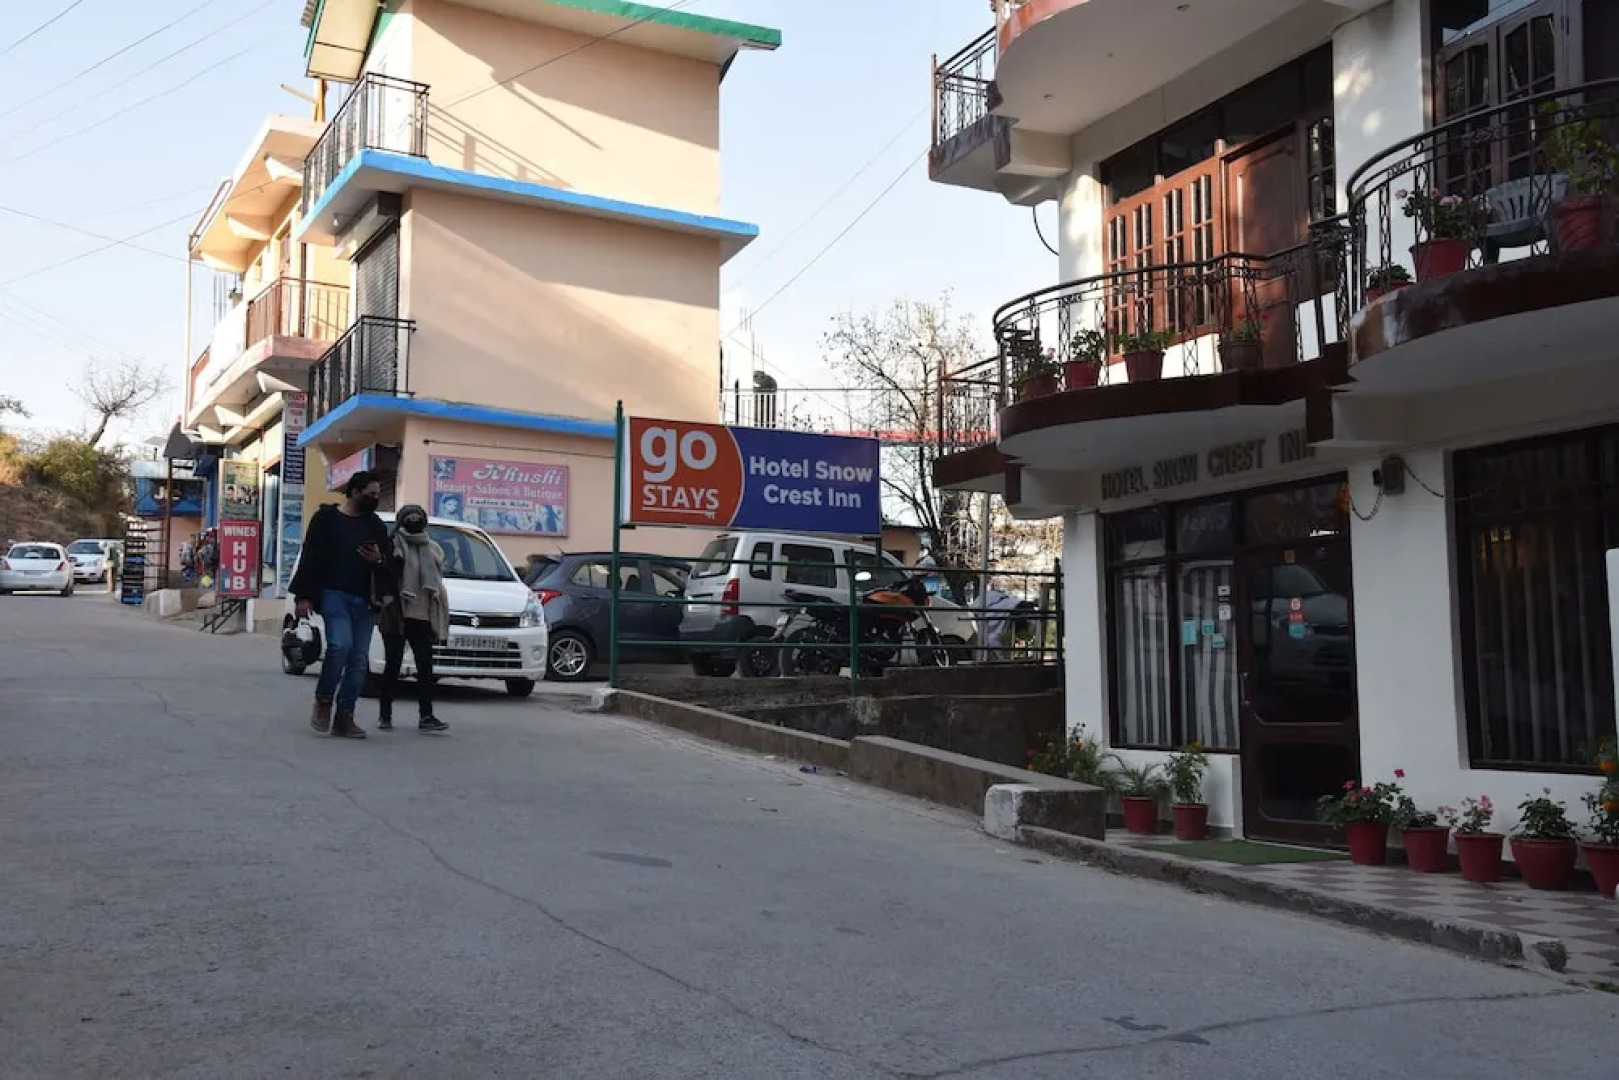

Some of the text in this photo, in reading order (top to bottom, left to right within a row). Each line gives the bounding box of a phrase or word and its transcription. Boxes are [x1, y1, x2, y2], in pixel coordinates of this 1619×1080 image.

[640, 426, 718, 482] go
[749, 455, 874, 482] Hotel Snow
[642, 484, 720, 511] STAYS
[763, 483, 862, 508] Crest Inn
[223, 525, 257, 537] WINES
[232, 540, 247, 591] HUB
